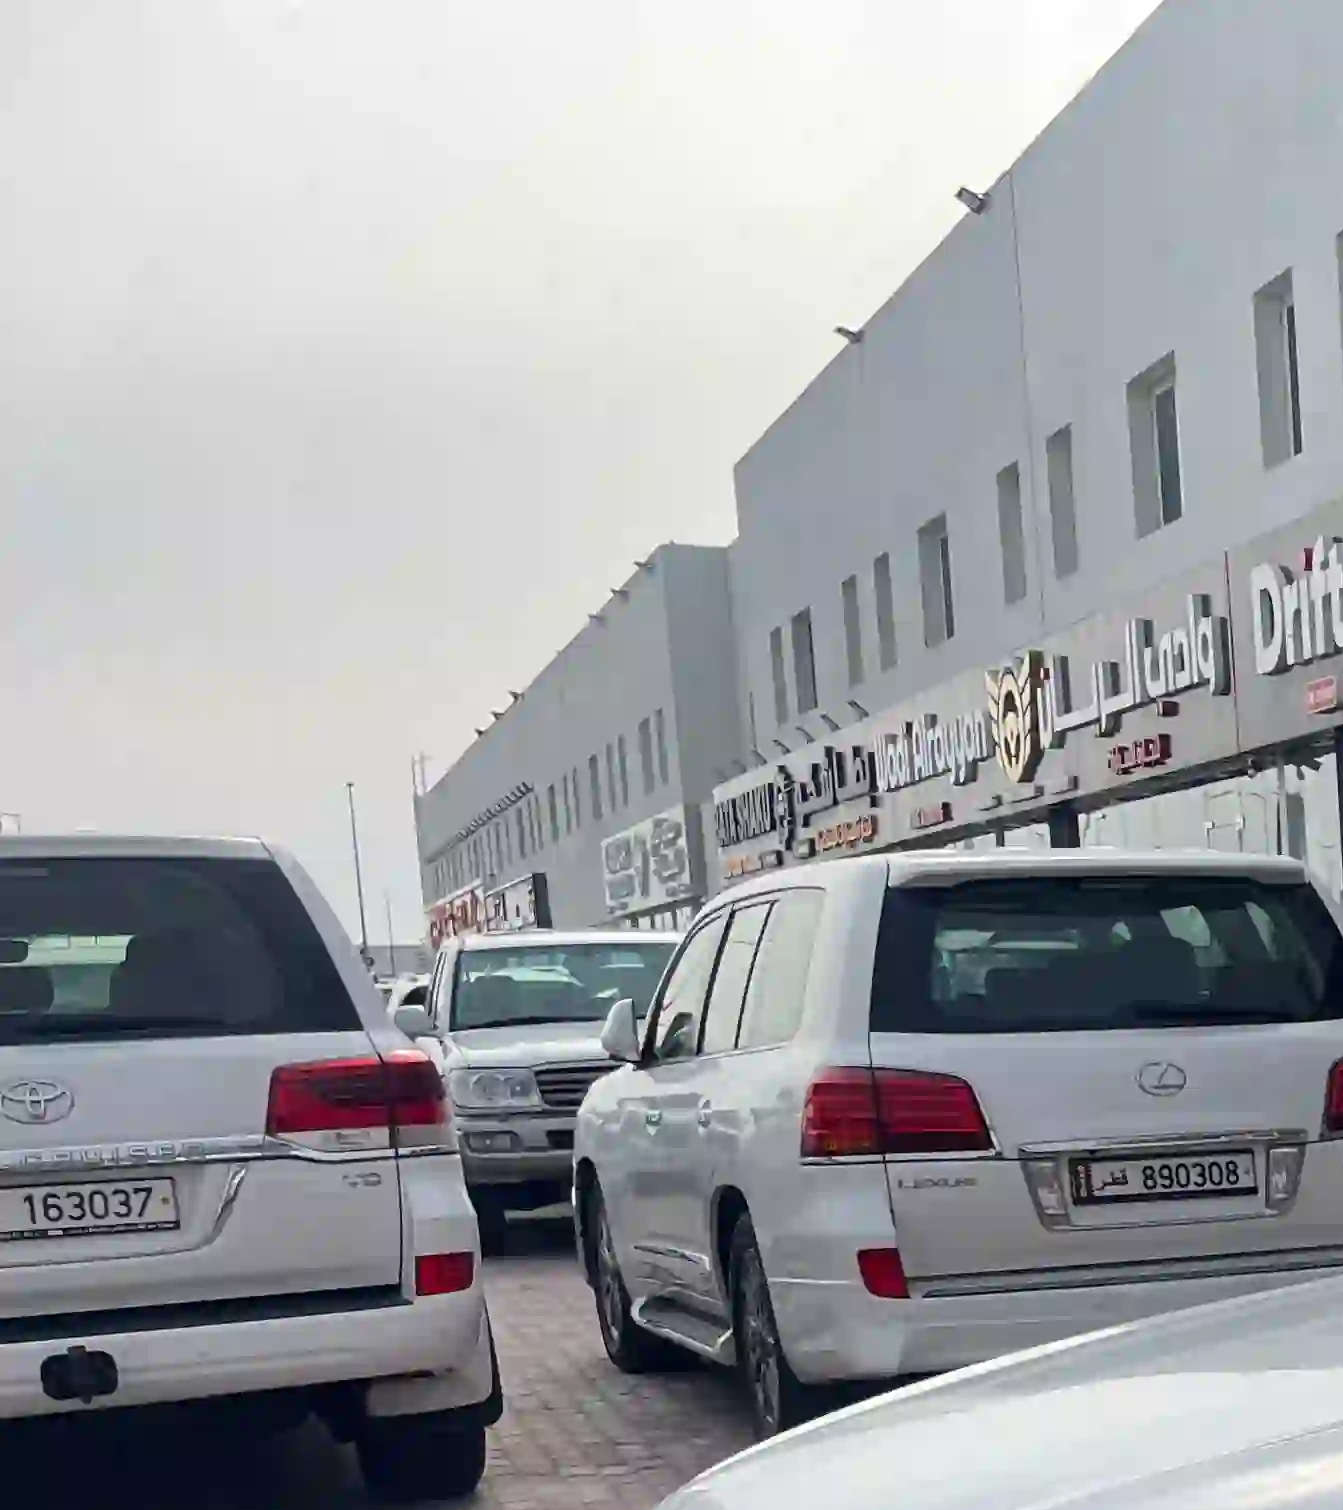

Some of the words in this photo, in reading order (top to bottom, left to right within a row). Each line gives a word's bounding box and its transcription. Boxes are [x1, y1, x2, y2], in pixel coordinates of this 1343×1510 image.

[1090, 1167, 1129, 1193] قطر
[1141, 1159, 1240, 1190] 890308
[22, 1186, 153, 1225] 163037
